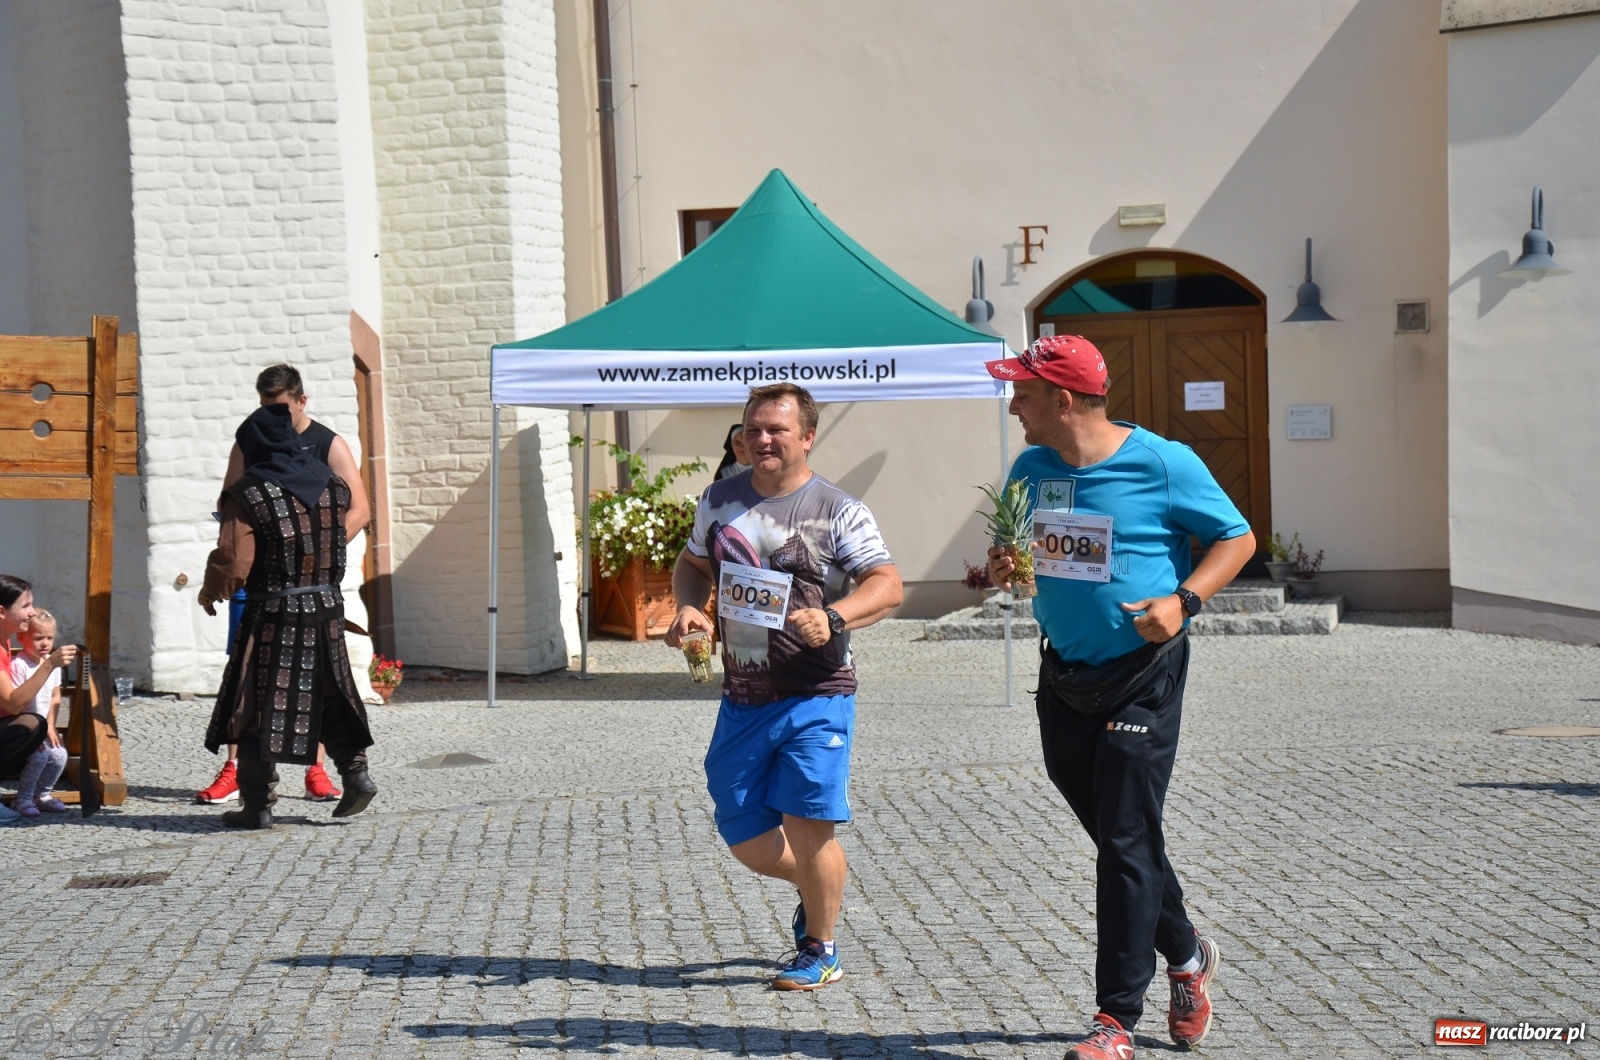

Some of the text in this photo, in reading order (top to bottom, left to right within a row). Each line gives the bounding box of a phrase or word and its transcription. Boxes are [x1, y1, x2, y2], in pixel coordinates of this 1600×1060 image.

[1018, 225, 1048, 264] F
[597, 358, 896, 384] www.zamekpiastowski.pl
[1046, 533, 1091, 556] 008
[731, 583, 771, 607] 003
[1114, 722, 1149, 733] Zeus
